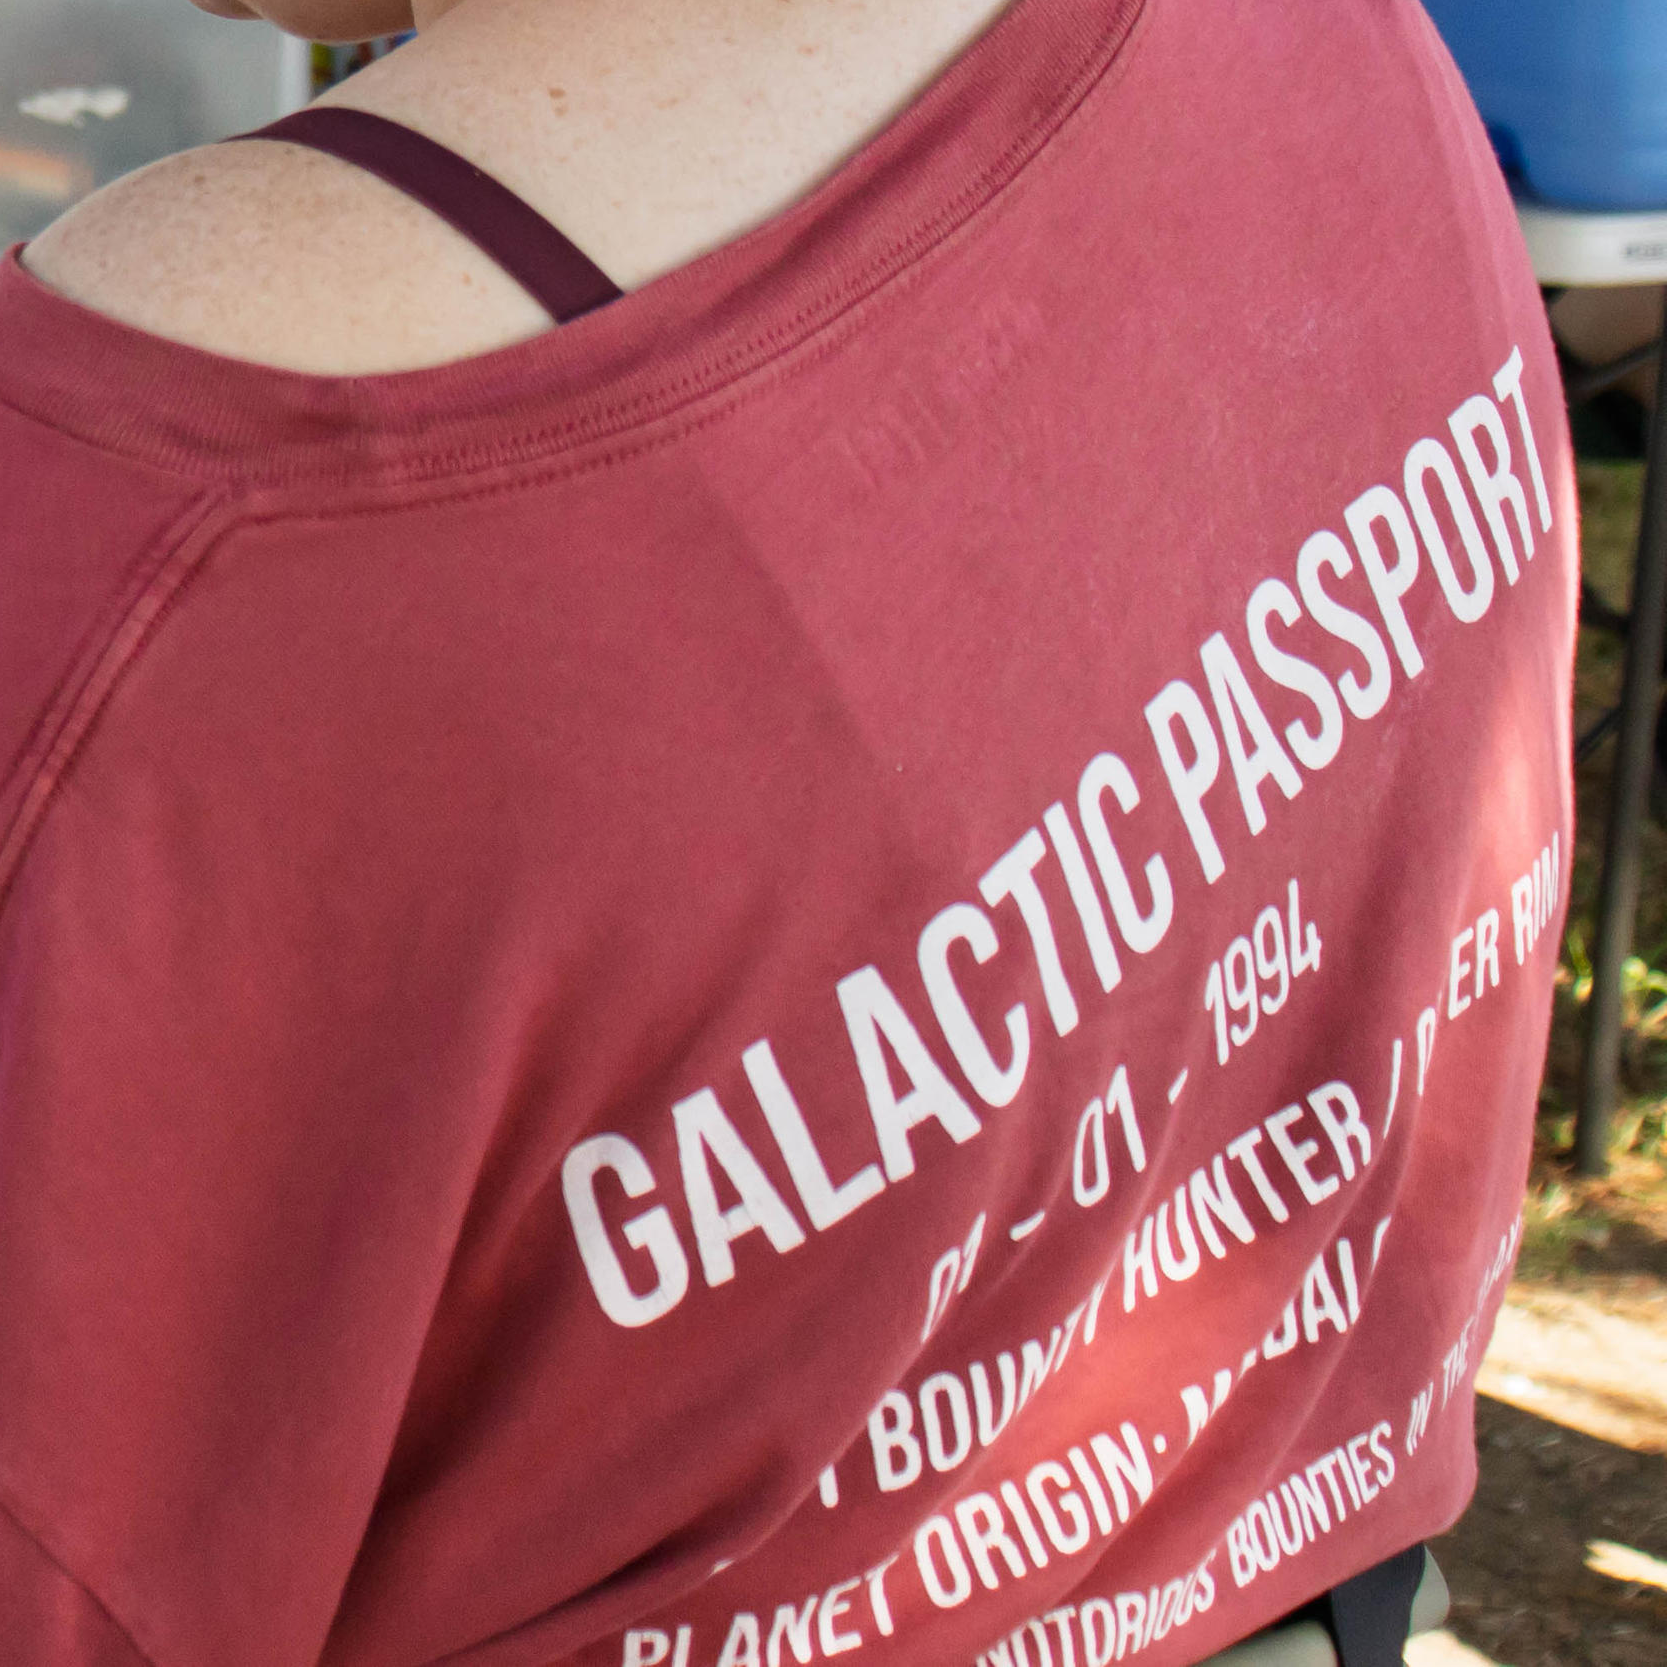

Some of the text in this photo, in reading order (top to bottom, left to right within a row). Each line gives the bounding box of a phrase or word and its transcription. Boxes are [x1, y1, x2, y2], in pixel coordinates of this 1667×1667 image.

[563, 343, 1556, 1327] GALACTIC PASSPORT
[1072, 1064, 1146, 1207] 01
[1204, 877, 1322, 1066] 1994
[1122, 1081, 1372, 1314] HUNTER
[1509, 830, 1560, 967] RIM
[1224, 1420, 1397, 1588] BOUNTIES
[1405, 1380, 1435, 1457] IN
